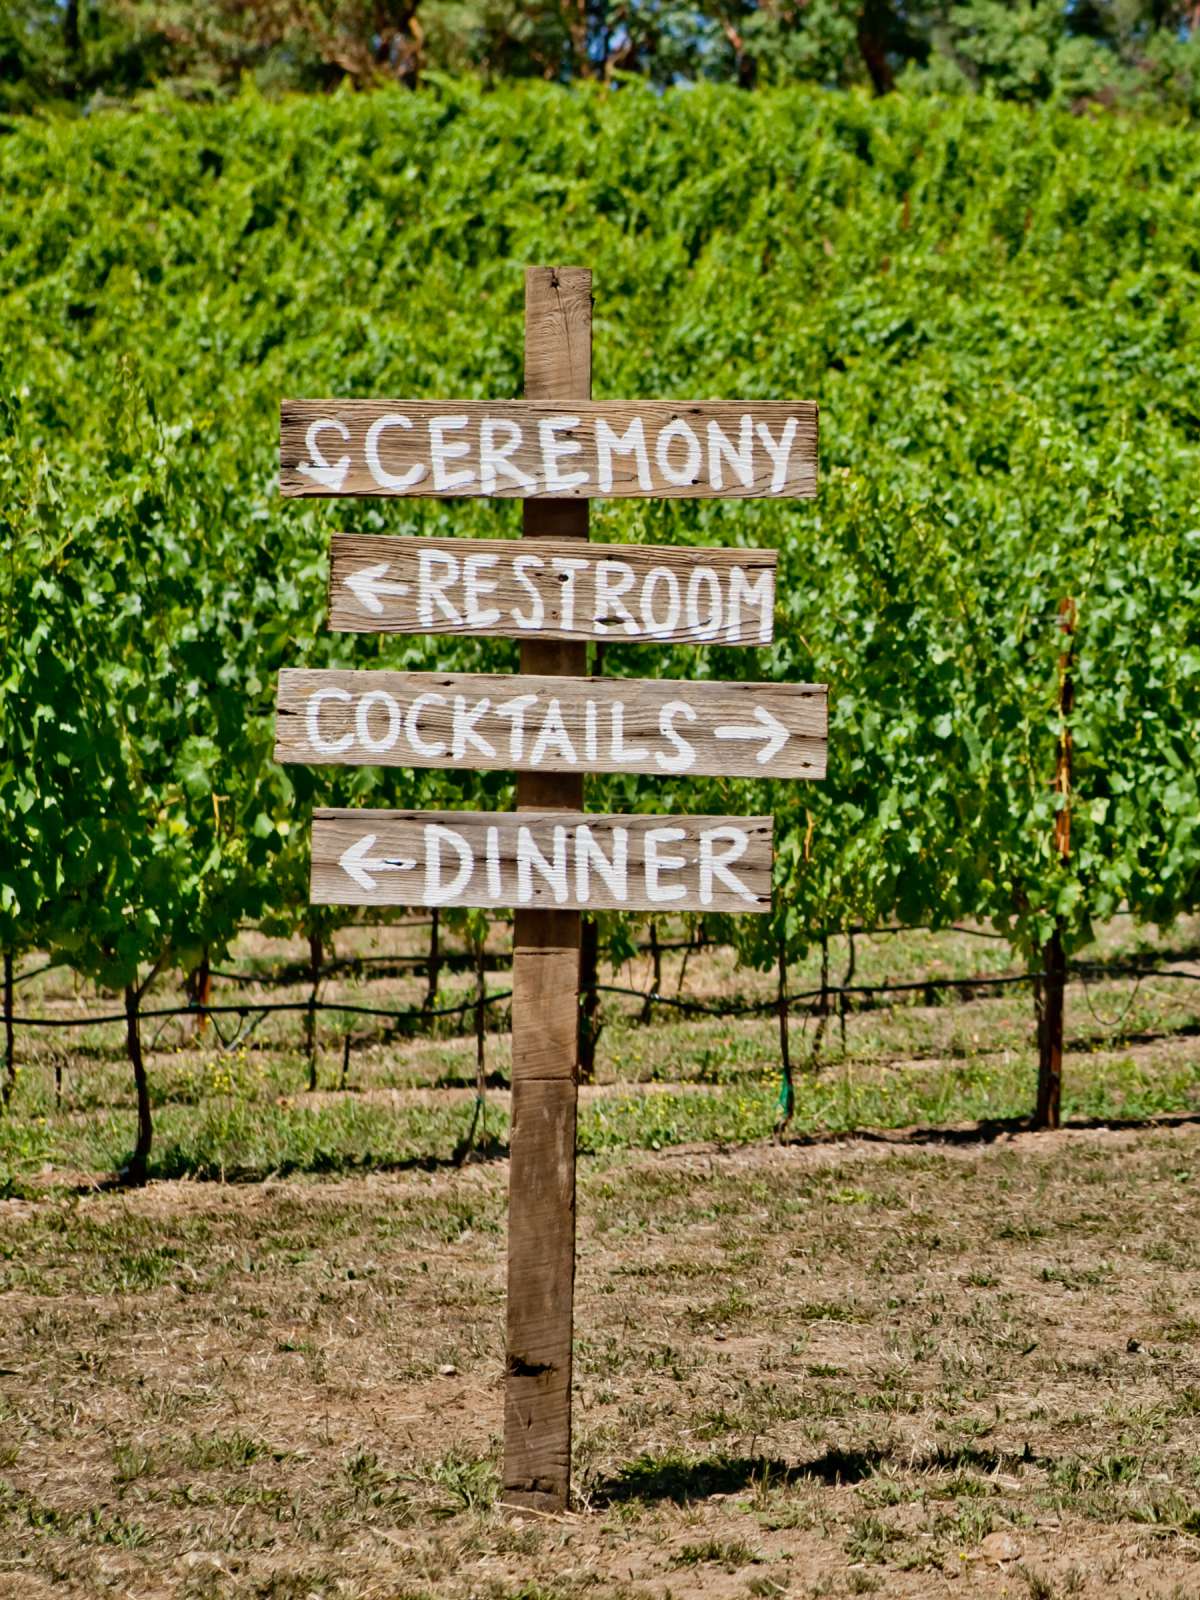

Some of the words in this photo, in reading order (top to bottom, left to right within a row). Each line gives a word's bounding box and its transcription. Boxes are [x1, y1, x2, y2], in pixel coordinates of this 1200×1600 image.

[365, 413, 799, 494] CEREMONY
[416, 549, 774, 643] RESTROOM
[306, 687, 697, 772] COCKTAILS
[423, 824, 760, 906] DINNER
